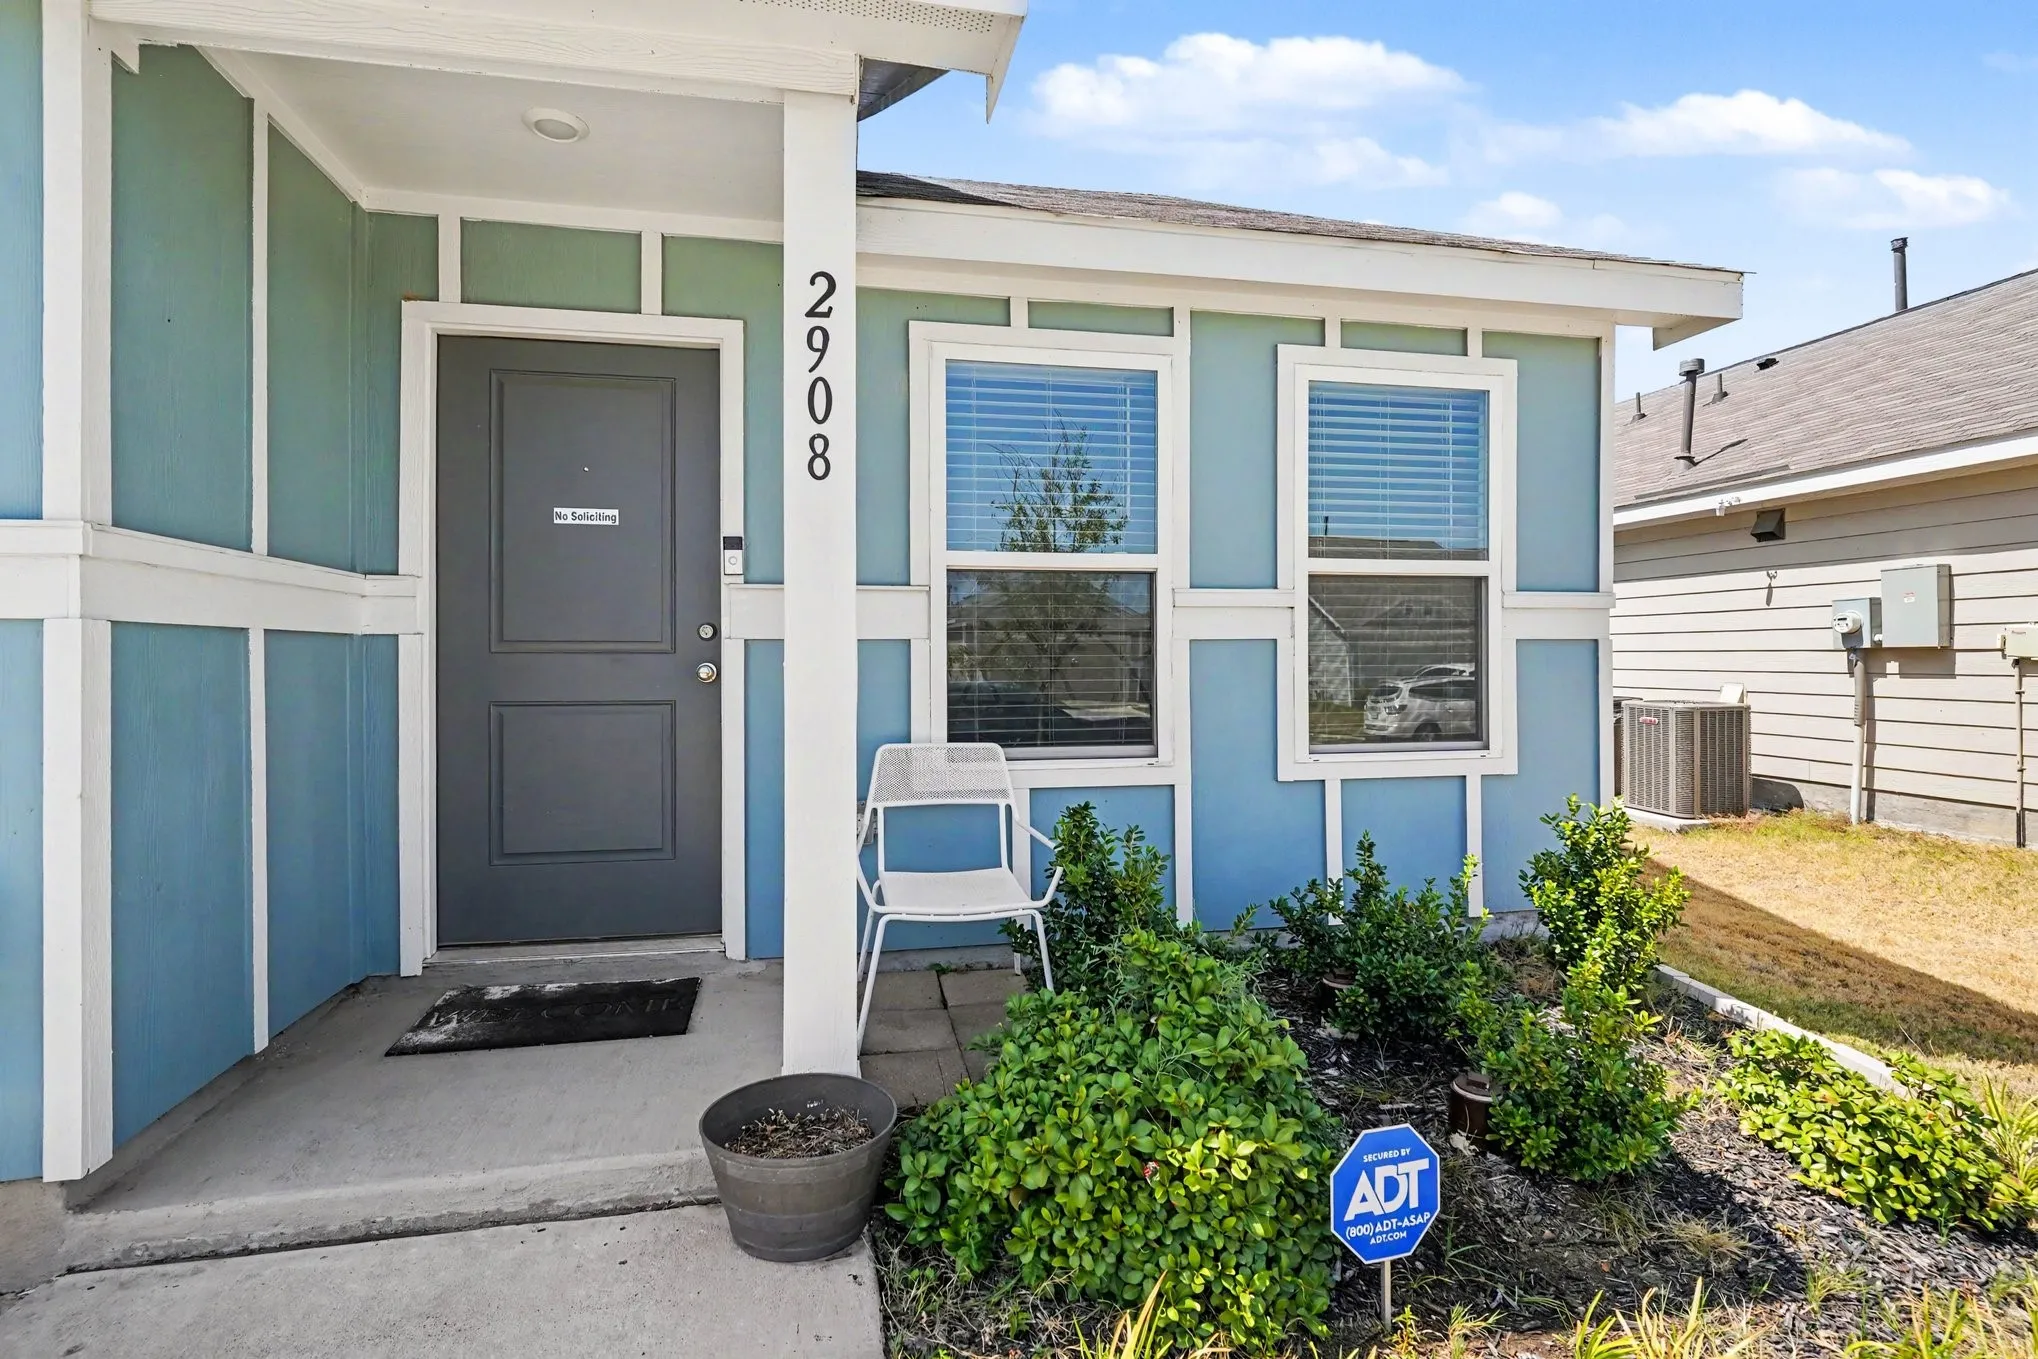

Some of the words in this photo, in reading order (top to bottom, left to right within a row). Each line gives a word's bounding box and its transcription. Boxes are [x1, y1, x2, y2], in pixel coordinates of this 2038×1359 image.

[804, 271, 837, 481] 2908
[555, 511, 568, 520] No
[571, 511, 617, 524] Soliciting
[1363, 1149, 1400, 1163] SECURED
[1401, 1147, 1411, 1157] BY
[1343, 1157, 1430, 1222] ADT
[1345, 1222, 1373, 1240] (800)
[1375, 1211, 1431, 1233] ADT-ASAP
[1369, 1230, 1407, 1245] ADT.COM
